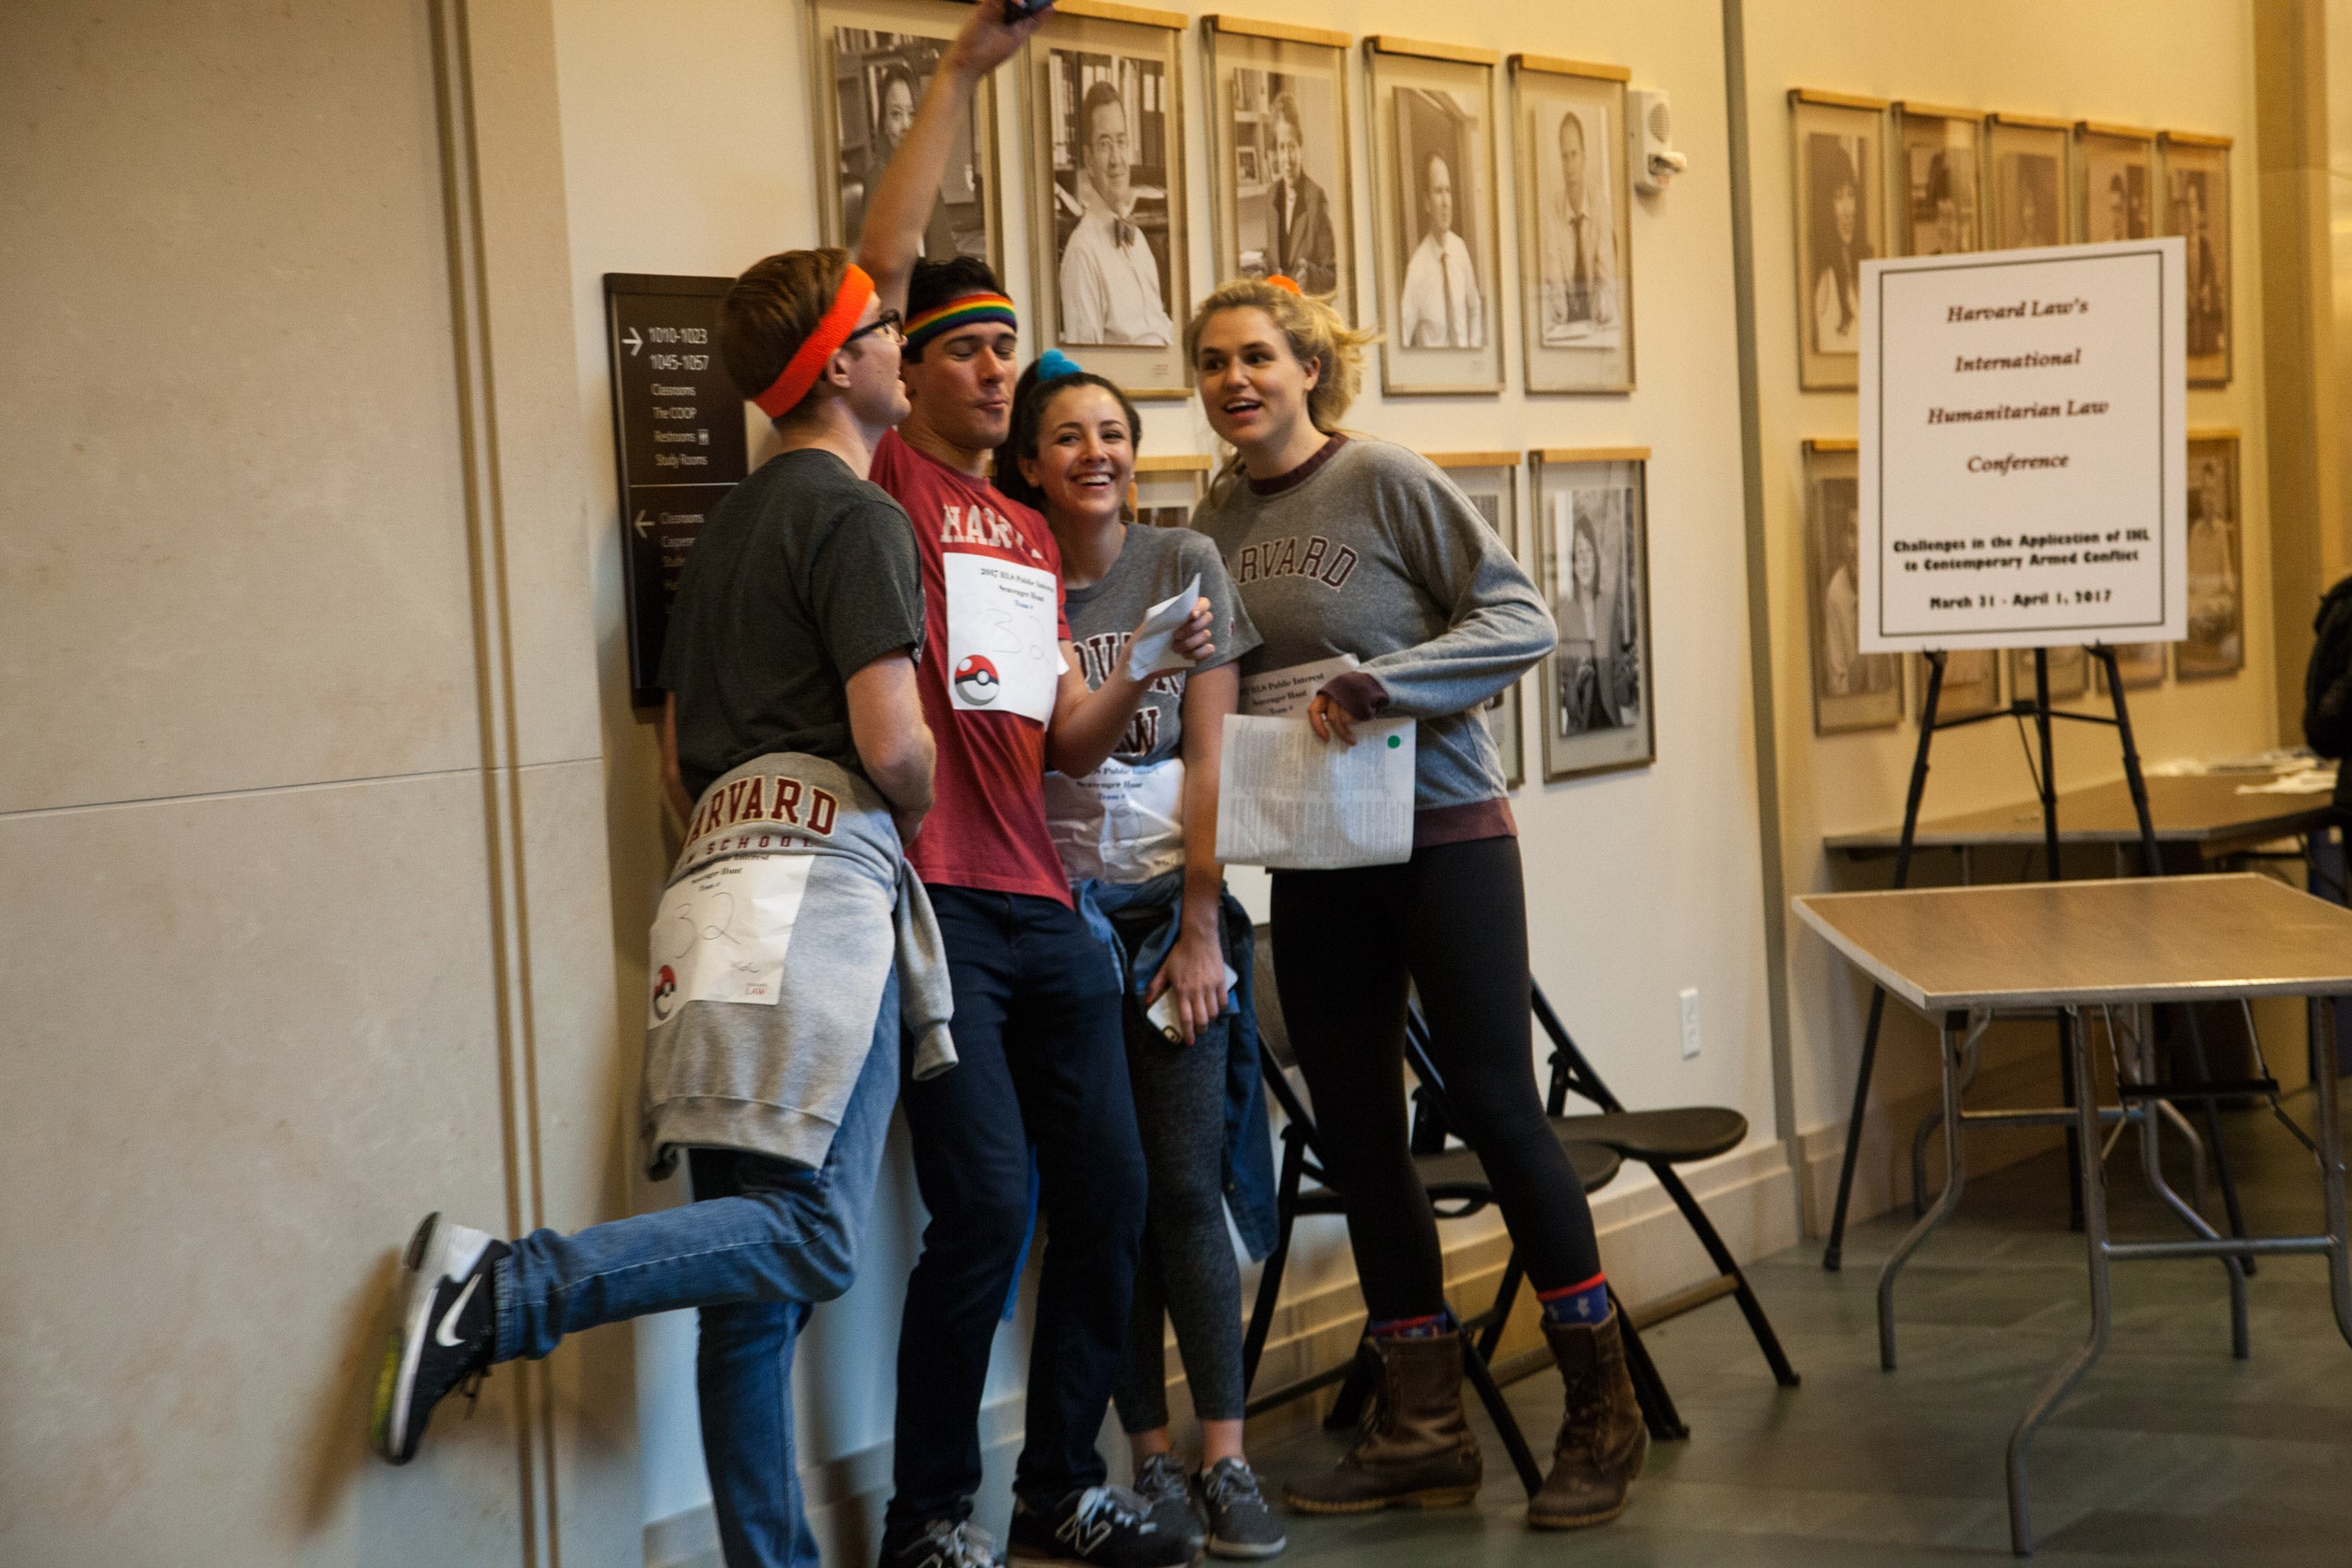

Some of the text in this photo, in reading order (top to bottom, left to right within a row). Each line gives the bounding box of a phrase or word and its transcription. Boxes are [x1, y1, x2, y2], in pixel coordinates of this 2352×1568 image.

[1947, 297, 2088, 323] Harvard Law's
[648, 327, 708, 344] 1010-1023
[649, 354, 709, 370] 1045-1057
[1954, 347, 2081, 373] International
[1928, 398, 2109, 424] Humanitarian Law
[1967, 453, 2070, 476] Conference
[1894, 539, 1966, 553] Challenges
[1972, 538, 1985, 549] in
[1990, 536, 2013, 548] the
[2019, 532, 2100, 548] Application
[2106, 529, 2120, 542] of
[1223, 535, 1359, 589] RVARD
[1905, 550, 2139, 572] to Contemporary Armed Conflict
[1930, 595, 1973, 610] March
[1979, 594, 1995, 608] 31
[2013, 592, 2049, 609] April
[2056, 591, 2069, 605] 1,
[2074, 588, 2111, 604] 2017
